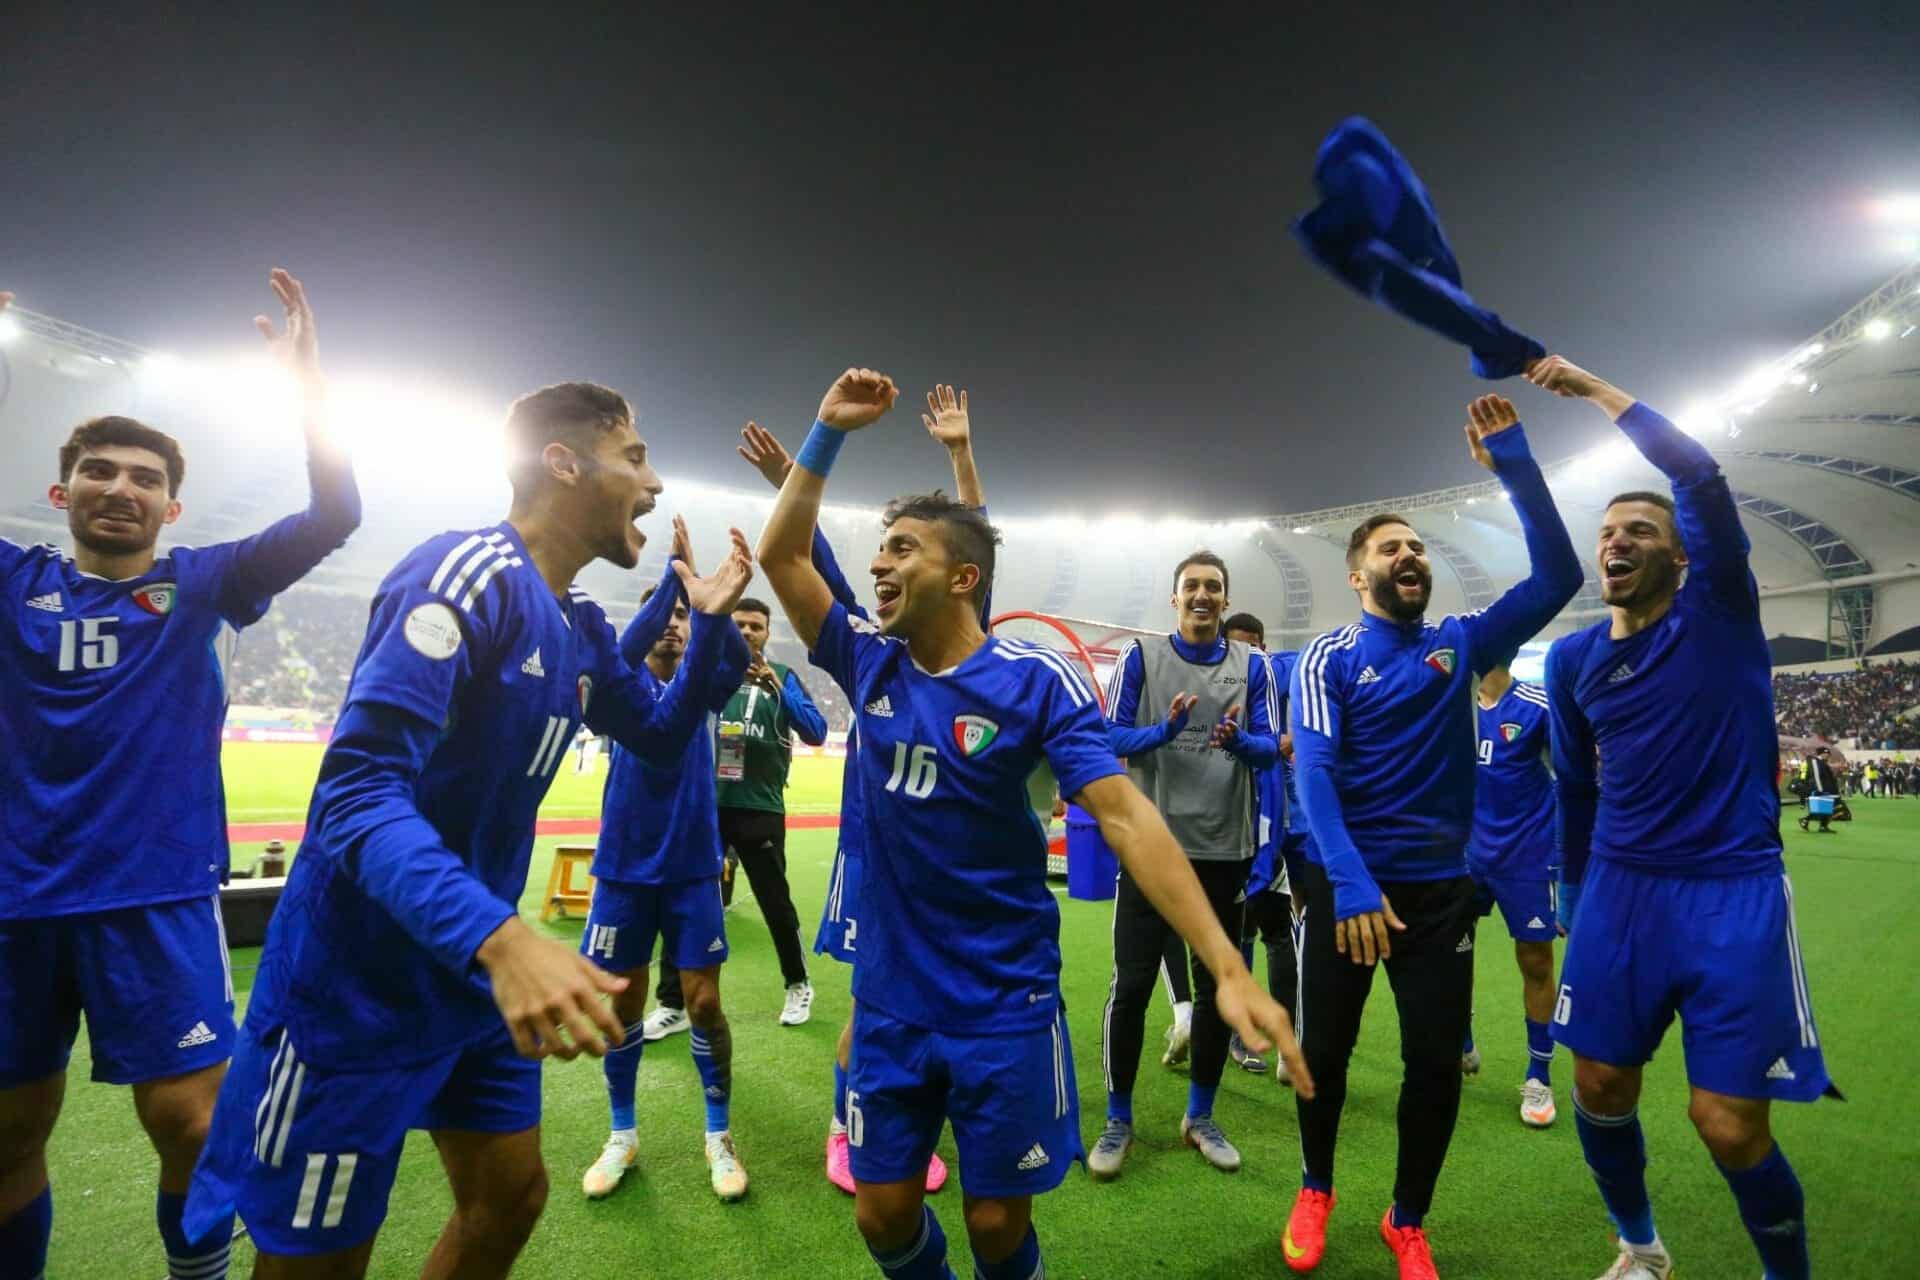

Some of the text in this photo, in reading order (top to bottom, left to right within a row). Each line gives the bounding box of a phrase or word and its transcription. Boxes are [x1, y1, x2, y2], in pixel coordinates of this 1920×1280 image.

[58, 616, 120, 672] 15
[526, 715, 569, 777] 11
[884, 741, 938, 799] 16
[587, 923, 617, 959] 14
[292, 1152, 358, 1229] 11
